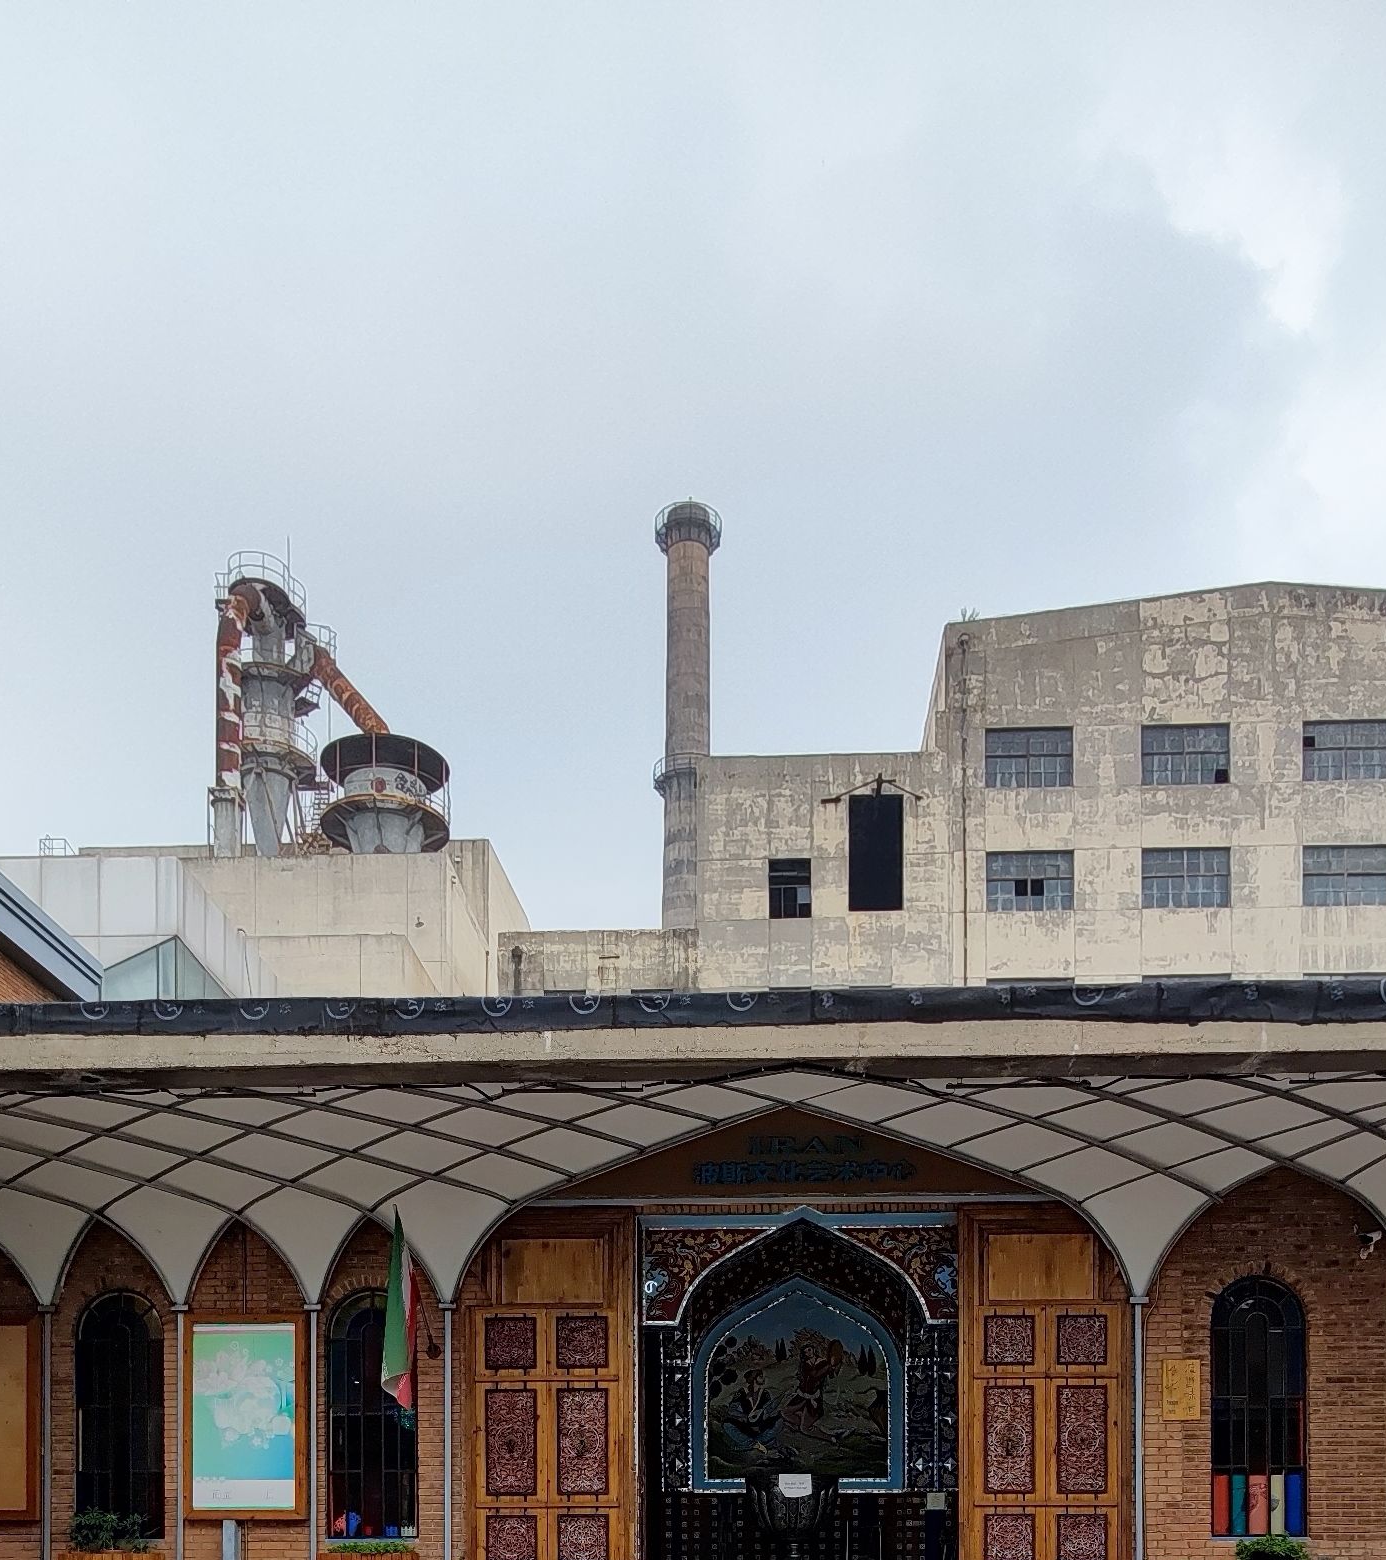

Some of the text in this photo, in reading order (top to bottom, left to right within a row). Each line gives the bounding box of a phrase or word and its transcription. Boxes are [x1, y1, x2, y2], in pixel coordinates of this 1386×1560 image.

[748, 1135, 862, 1155] IRAN
[693, 1158, 917, 1185] 波斯文化艺术中心
